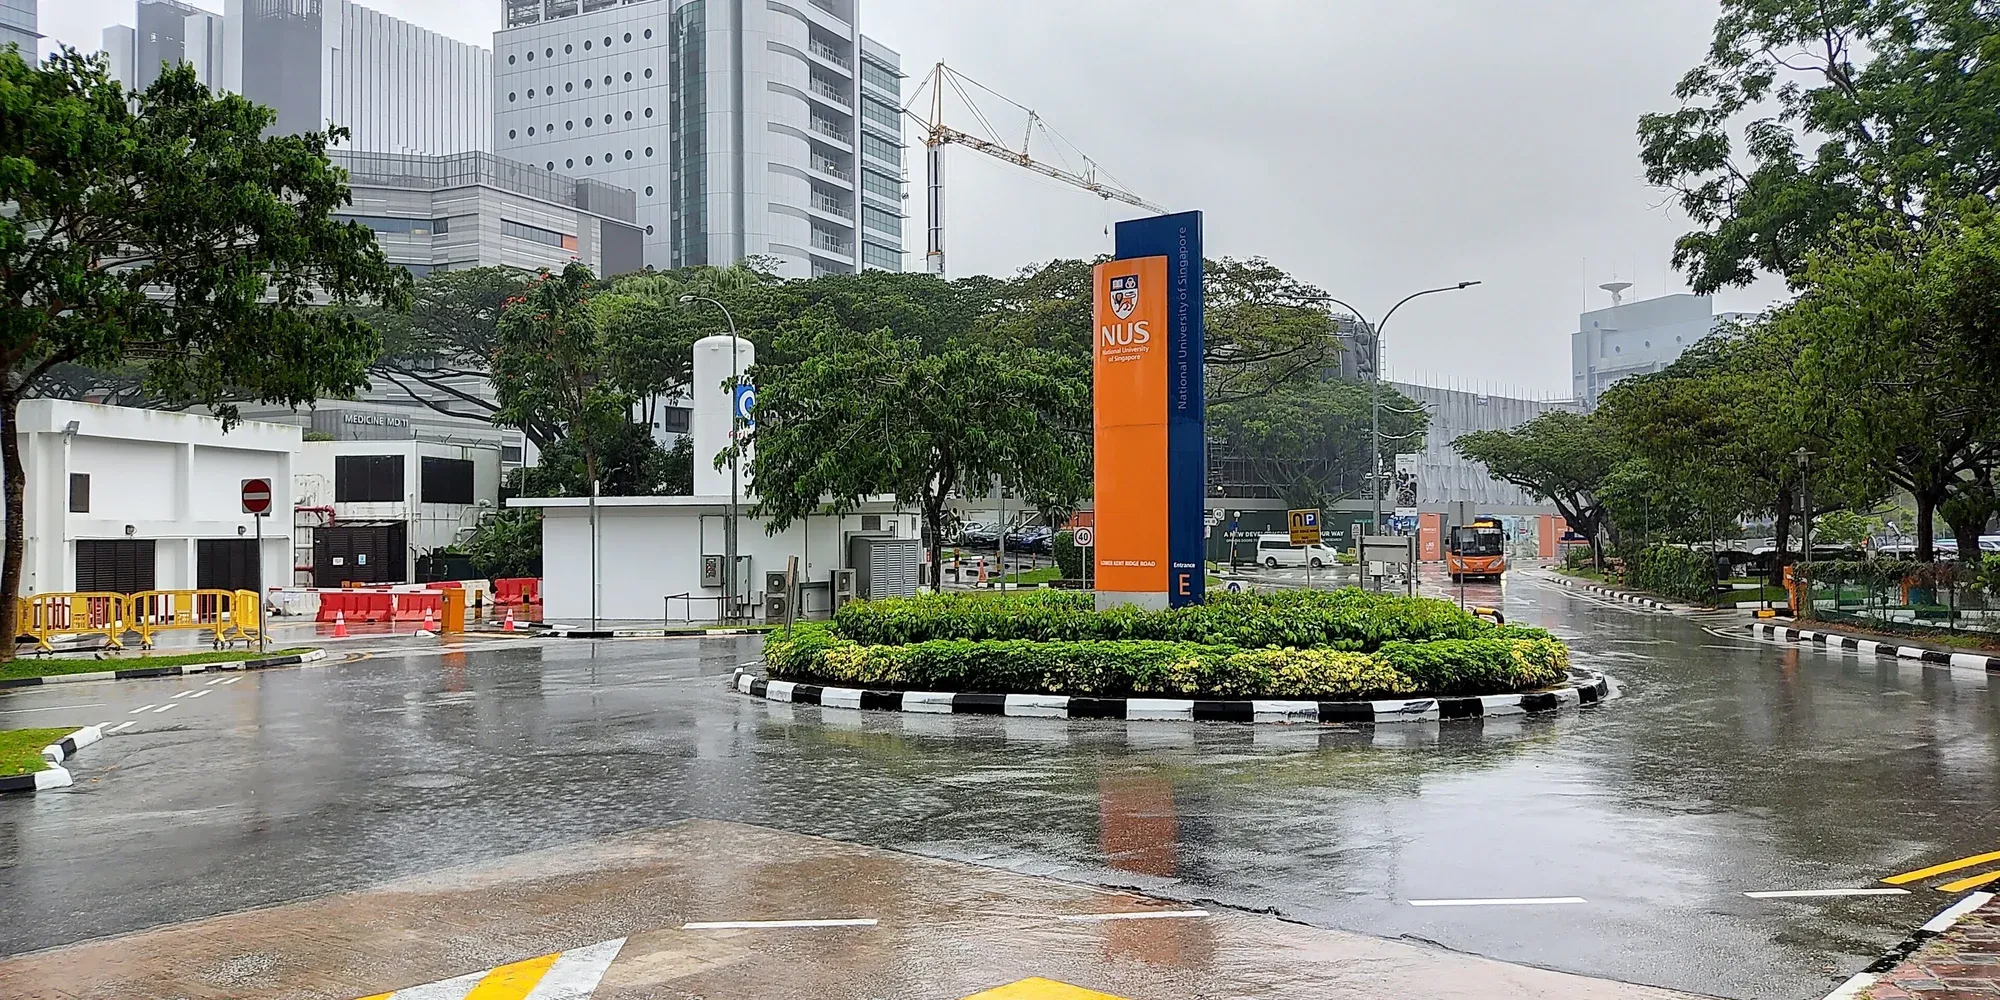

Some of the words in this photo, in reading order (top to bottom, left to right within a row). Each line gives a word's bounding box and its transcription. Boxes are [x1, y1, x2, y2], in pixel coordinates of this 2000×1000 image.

[1177, 226, 1189, 285] Singapore
[1177, 287, 1187, 300] of
[1101, 320, 1150, 348] NUS
[1177, 302, 1189, 358] University
[1121, 345, 1150, 354] University
[1114, 354, 1141, 363] Singapore
[1177, 361, 1188, 409] National
[344, 414, 384, 425] MEDICINE
[387, 417, 400, 427] MD
[402, 419, 409, 427] 11
[1305, 514, 1314, 525] P
[1078, 532, 1089, 541] 40
[1179, 574, 1190, 595] E
